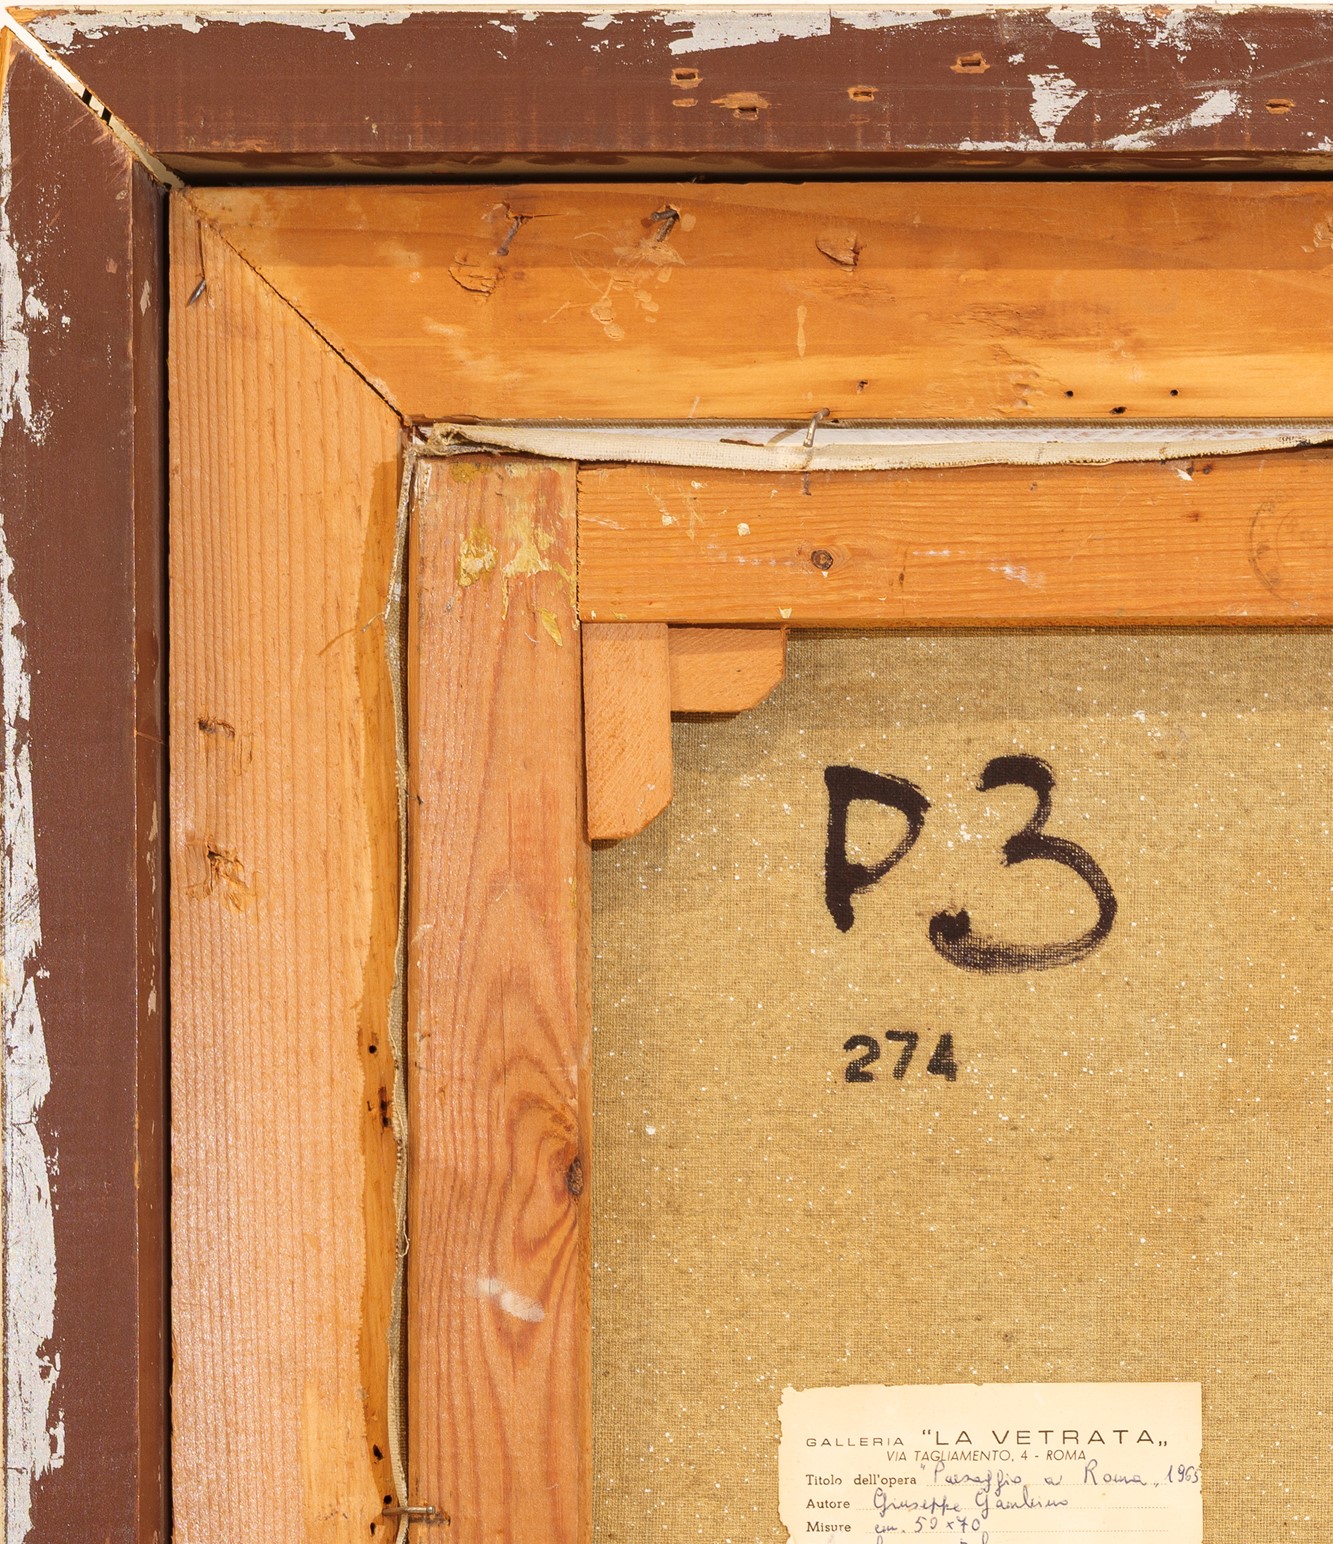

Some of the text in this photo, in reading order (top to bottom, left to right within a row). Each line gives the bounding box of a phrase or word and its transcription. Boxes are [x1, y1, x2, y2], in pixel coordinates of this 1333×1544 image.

[843, 1030, 958, 1083] 274
[806, 1437, 905, 1447] GALLERIA
[887, 1450, 907, 1462] VIA
[914, 1450, 1014, 1462] TAGLIAMENTO,
[1020, 1450, 1028, 1461] 4
[1046, 1449, 1087, 1461] ROMA
[1166, 1464, 1200, 1484] 1965
[806, 1474, 917, 1489] Titolo dell'opera
[806, 1498, 850, 1509] Autore
[873, 1485, 1068, 1519] Giuseppe Gambino
[806, 1521, 851, 1533] Misure
